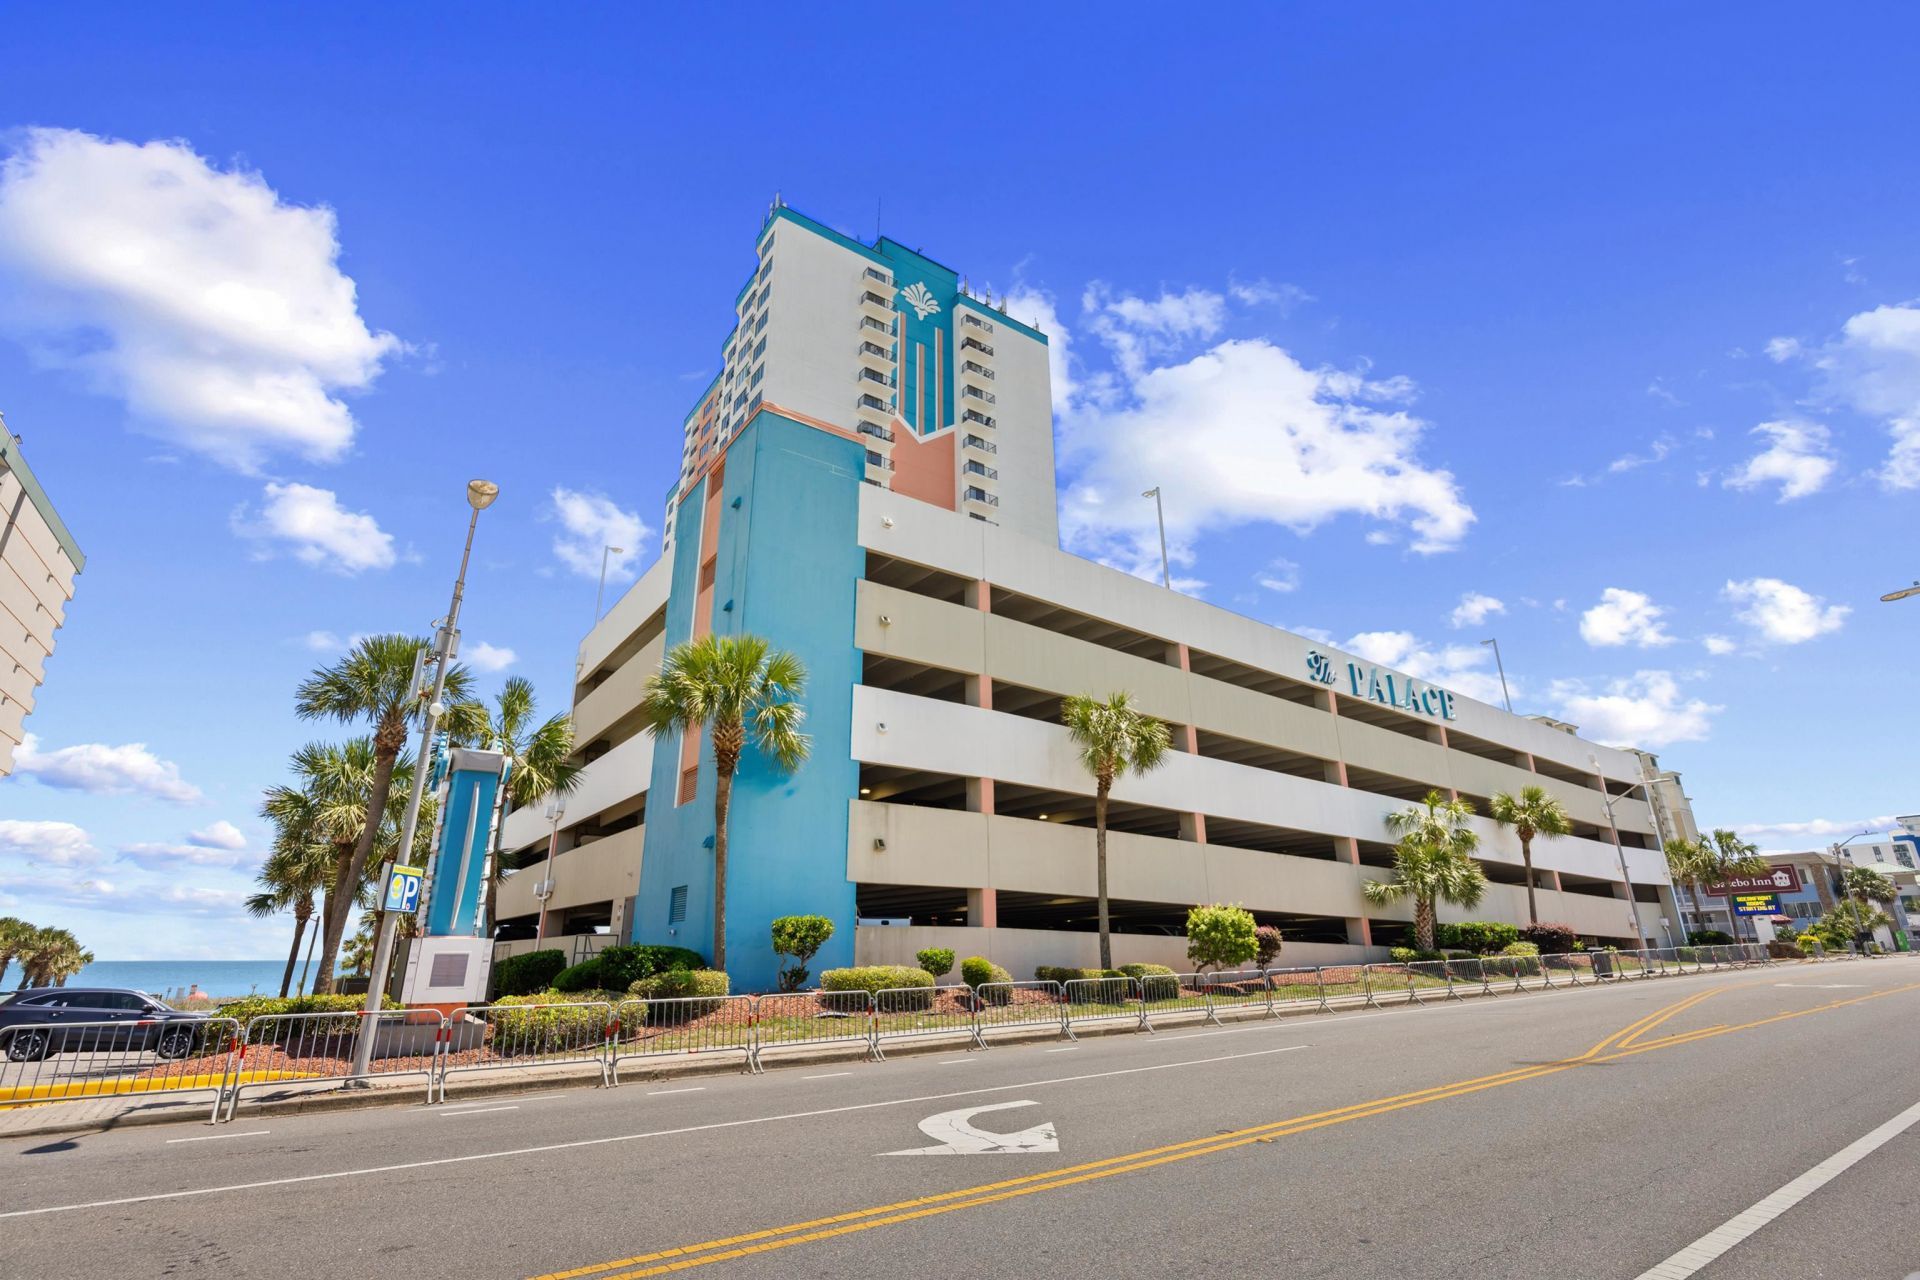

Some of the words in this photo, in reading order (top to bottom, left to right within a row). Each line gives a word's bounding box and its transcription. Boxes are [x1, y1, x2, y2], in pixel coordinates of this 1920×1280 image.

[1307, 651, 1336, 684] The
[1348, 662, 1456, 720] PALACE
[402, 876, 418, 909] P
[1712, 878, 1750, 888] Gaebo
[1752, 878, 1772, 886] Inn
